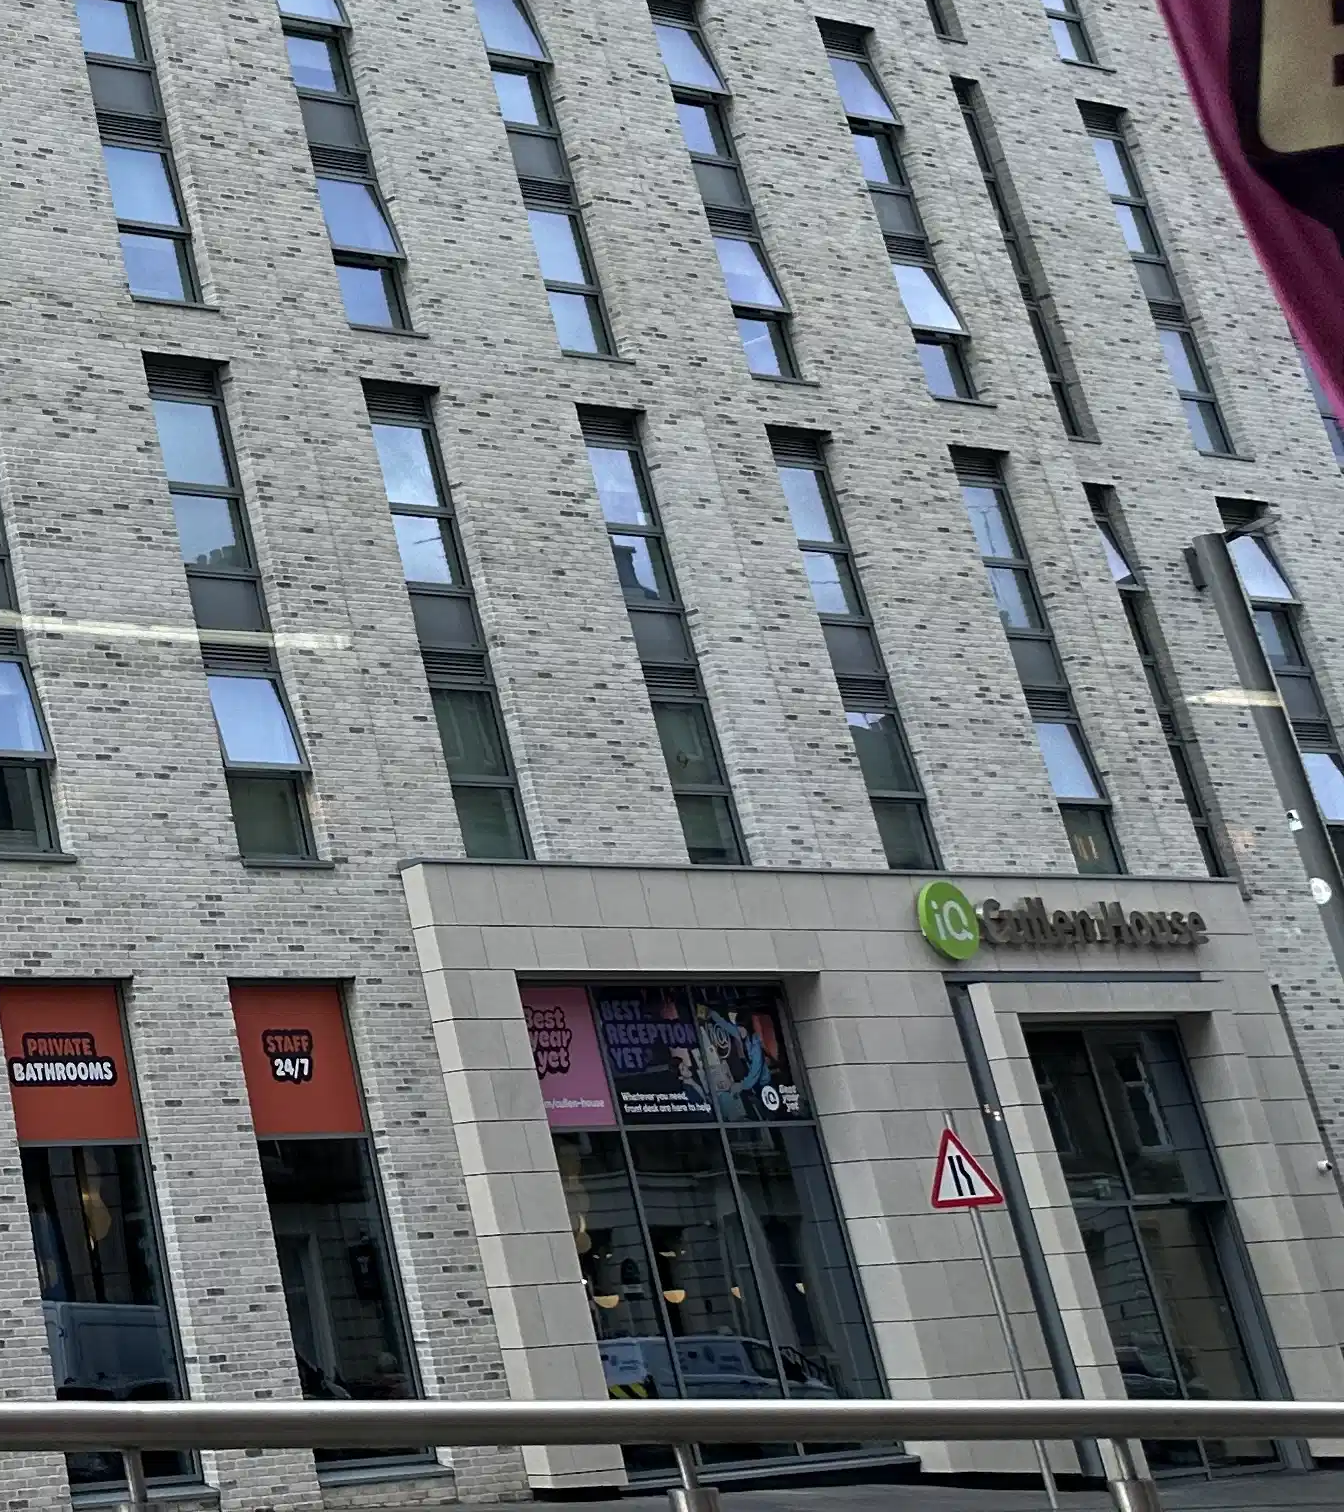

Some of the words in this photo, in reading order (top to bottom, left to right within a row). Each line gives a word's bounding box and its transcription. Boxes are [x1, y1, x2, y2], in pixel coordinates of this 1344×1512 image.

[931, 899, 974, 941] iQ
[977, 896, 1097, 944] Cullen
[1094, 901, 1209, 944] House
[600, 1001, 640, 1020] BEST
[266, 1035, 309, 1053] STAFF
[605, 1024, 696, 1044] RECEPTION
[27, 1038, 93, 1056] PRIVATE
[537, 1048, 569, 1074] yet
[611, 1047, 643, 1068] YET
[12, 1061, 113, 1081] BATHROOMS
[274, 1057, 309, 1079] 24/7
